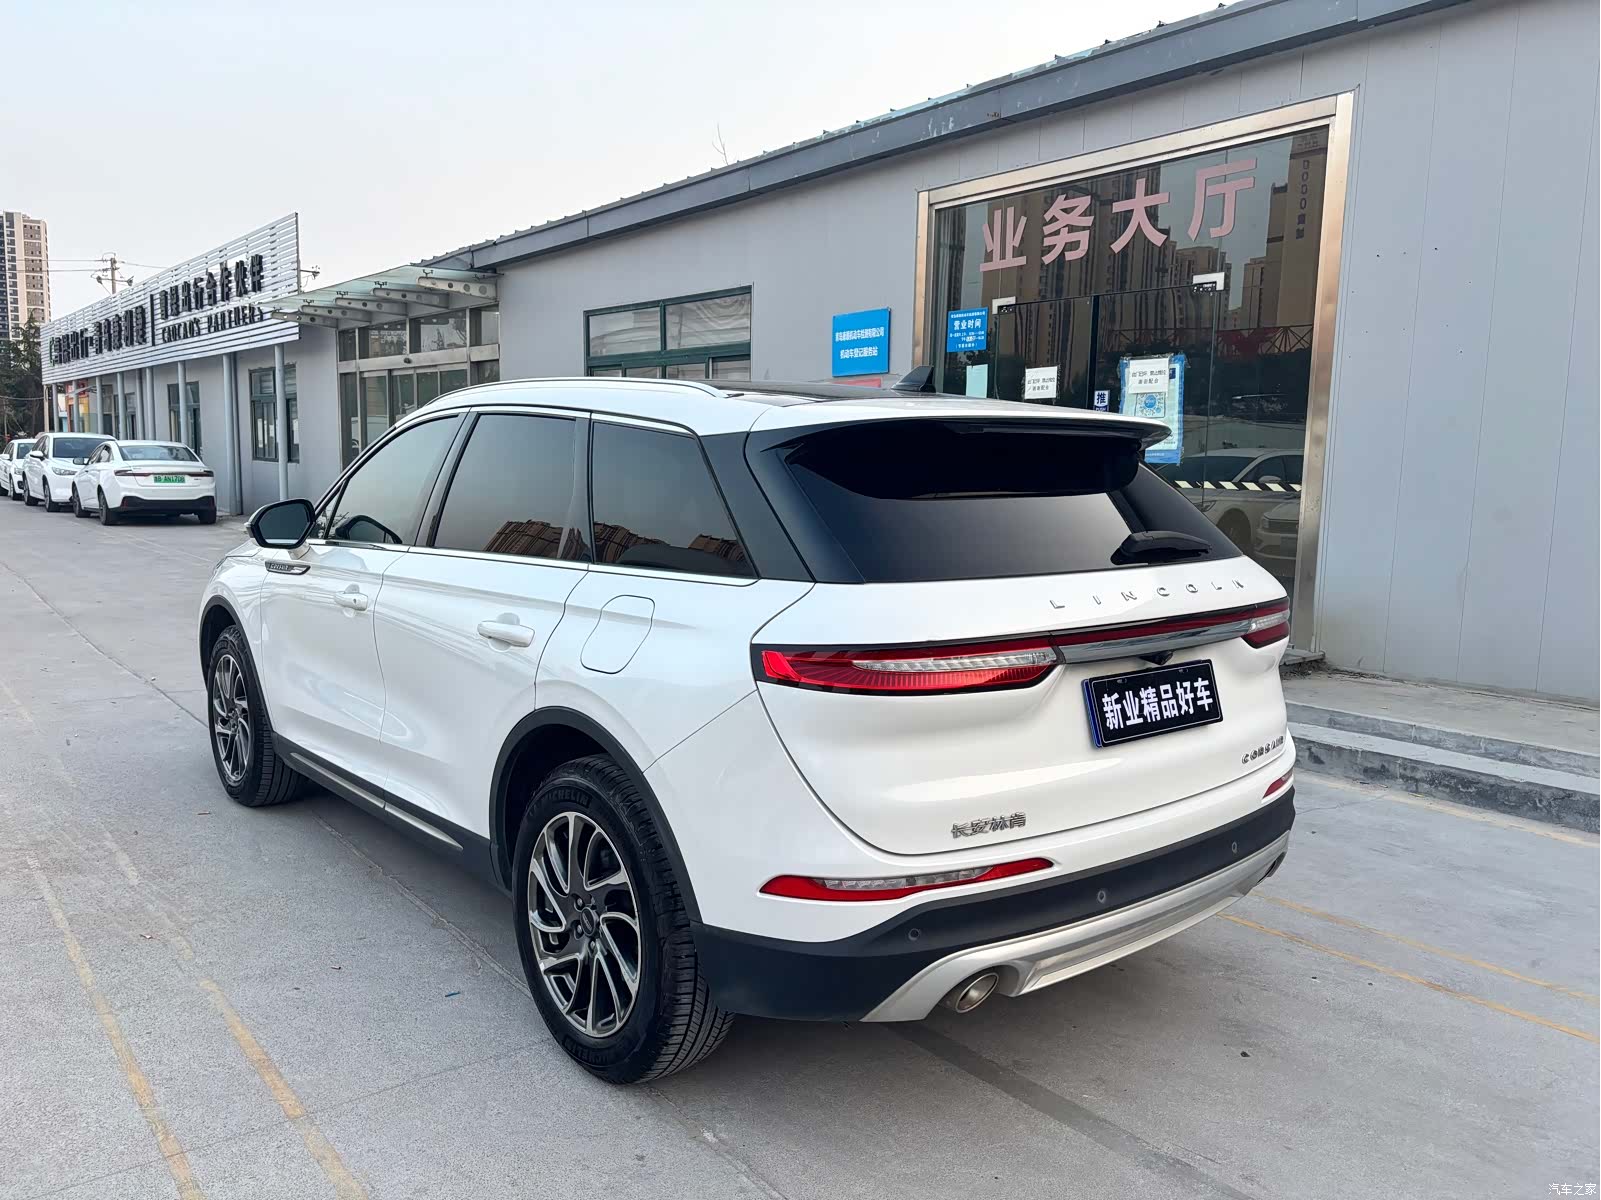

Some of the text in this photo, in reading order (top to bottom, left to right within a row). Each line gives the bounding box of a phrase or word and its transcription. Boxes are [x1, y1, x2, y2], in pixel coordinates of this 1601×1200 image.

[979, 157, 1257, 272] 业务大厅
[1096, 392, 1107, 405] 推
[1049, 578, 1245, 609] LINCOLN
[1101, 677, 1214, 731] 新业精品好车
[951, 811, 1026, 839] 长安林肯
